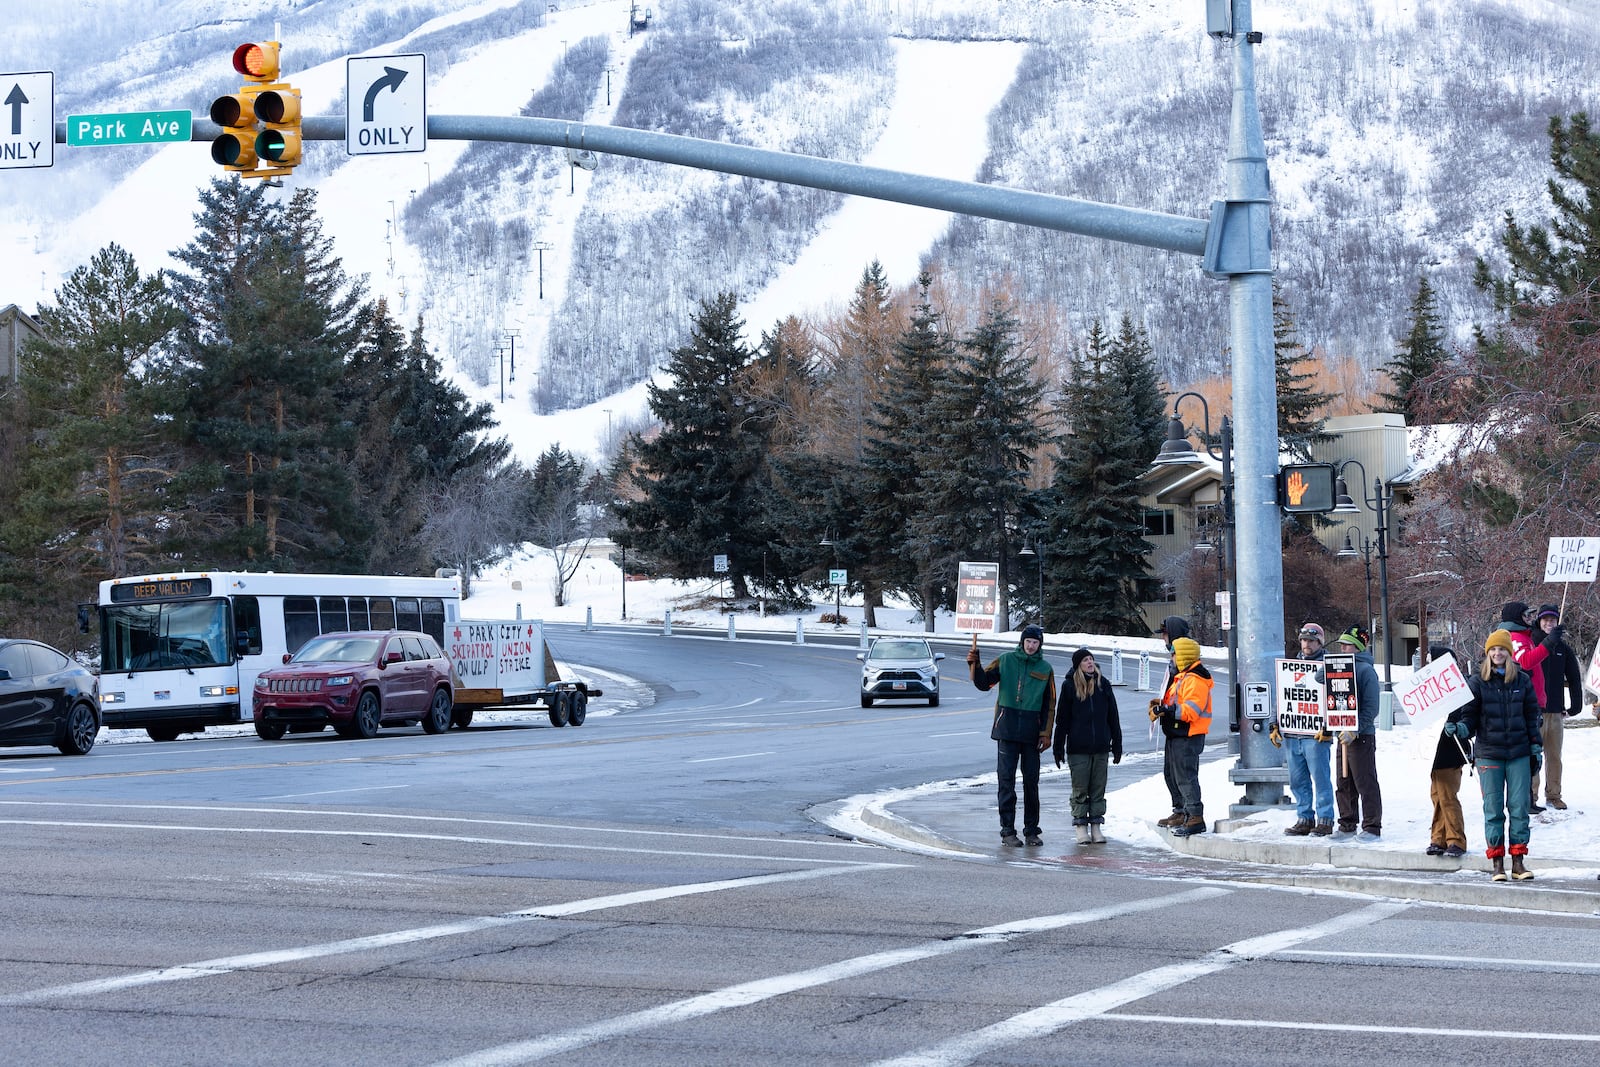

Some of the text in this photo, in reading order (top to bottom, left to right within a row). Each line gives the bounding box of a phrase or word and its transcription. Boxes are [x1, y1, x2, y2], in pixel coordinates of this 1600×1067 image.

[78, 118, 180, 140] Park Ave
[359, 126, 414, 146] ONLY
[0, 141, 41, 160] NLY
[1561, 538, 1585, 554] ULP
[1547, 554, 1595, 576] STRIKE
[134, 580, 192, 598] DEER VALLEY
[966, 585, 989, 598] STRIKE
[469, 624, 522, 642] PARK CITY
[973, 619, 993, 630] STRONG
[502, 641, 532, 657] UNION
[457, 657, 531, 677] ON ULP STRIKE
[1282, 662, 1318, 673] PCPSPA
[1331, 678, 1350, 692] STRIKE
[1403, 662, 1465, 716] STRIKE!
[1284, 687, 1318, 702] NEEDS
[1286, 702, 1319, 715] A FAIR
[1280, 713, 1324, 730] CONTRACT
